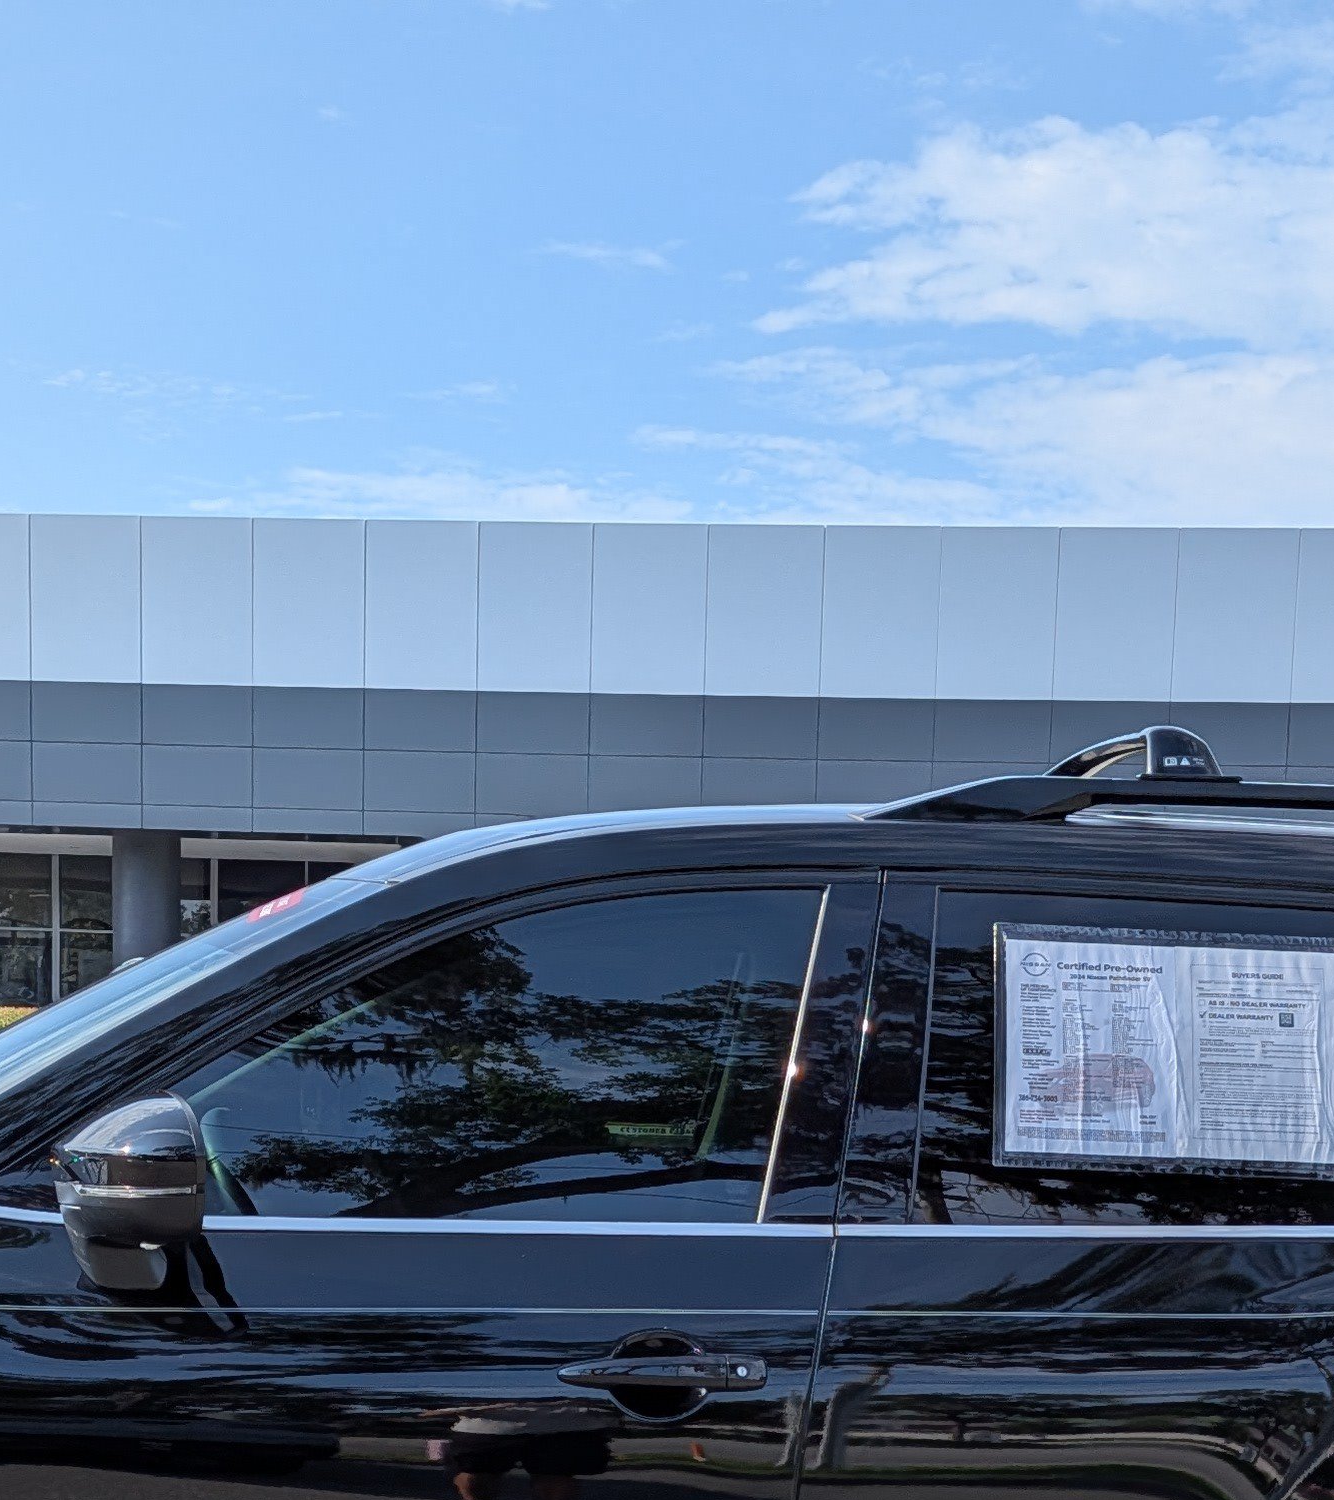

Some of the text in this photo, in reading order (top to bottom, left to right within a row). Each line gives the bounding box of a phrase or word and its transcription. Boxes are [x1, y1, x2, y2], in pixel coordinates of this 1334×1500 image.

[1056, 961, 1163, 974] Certified Pre-Owned
[1231, 972, 1261, 980] BUYERS
